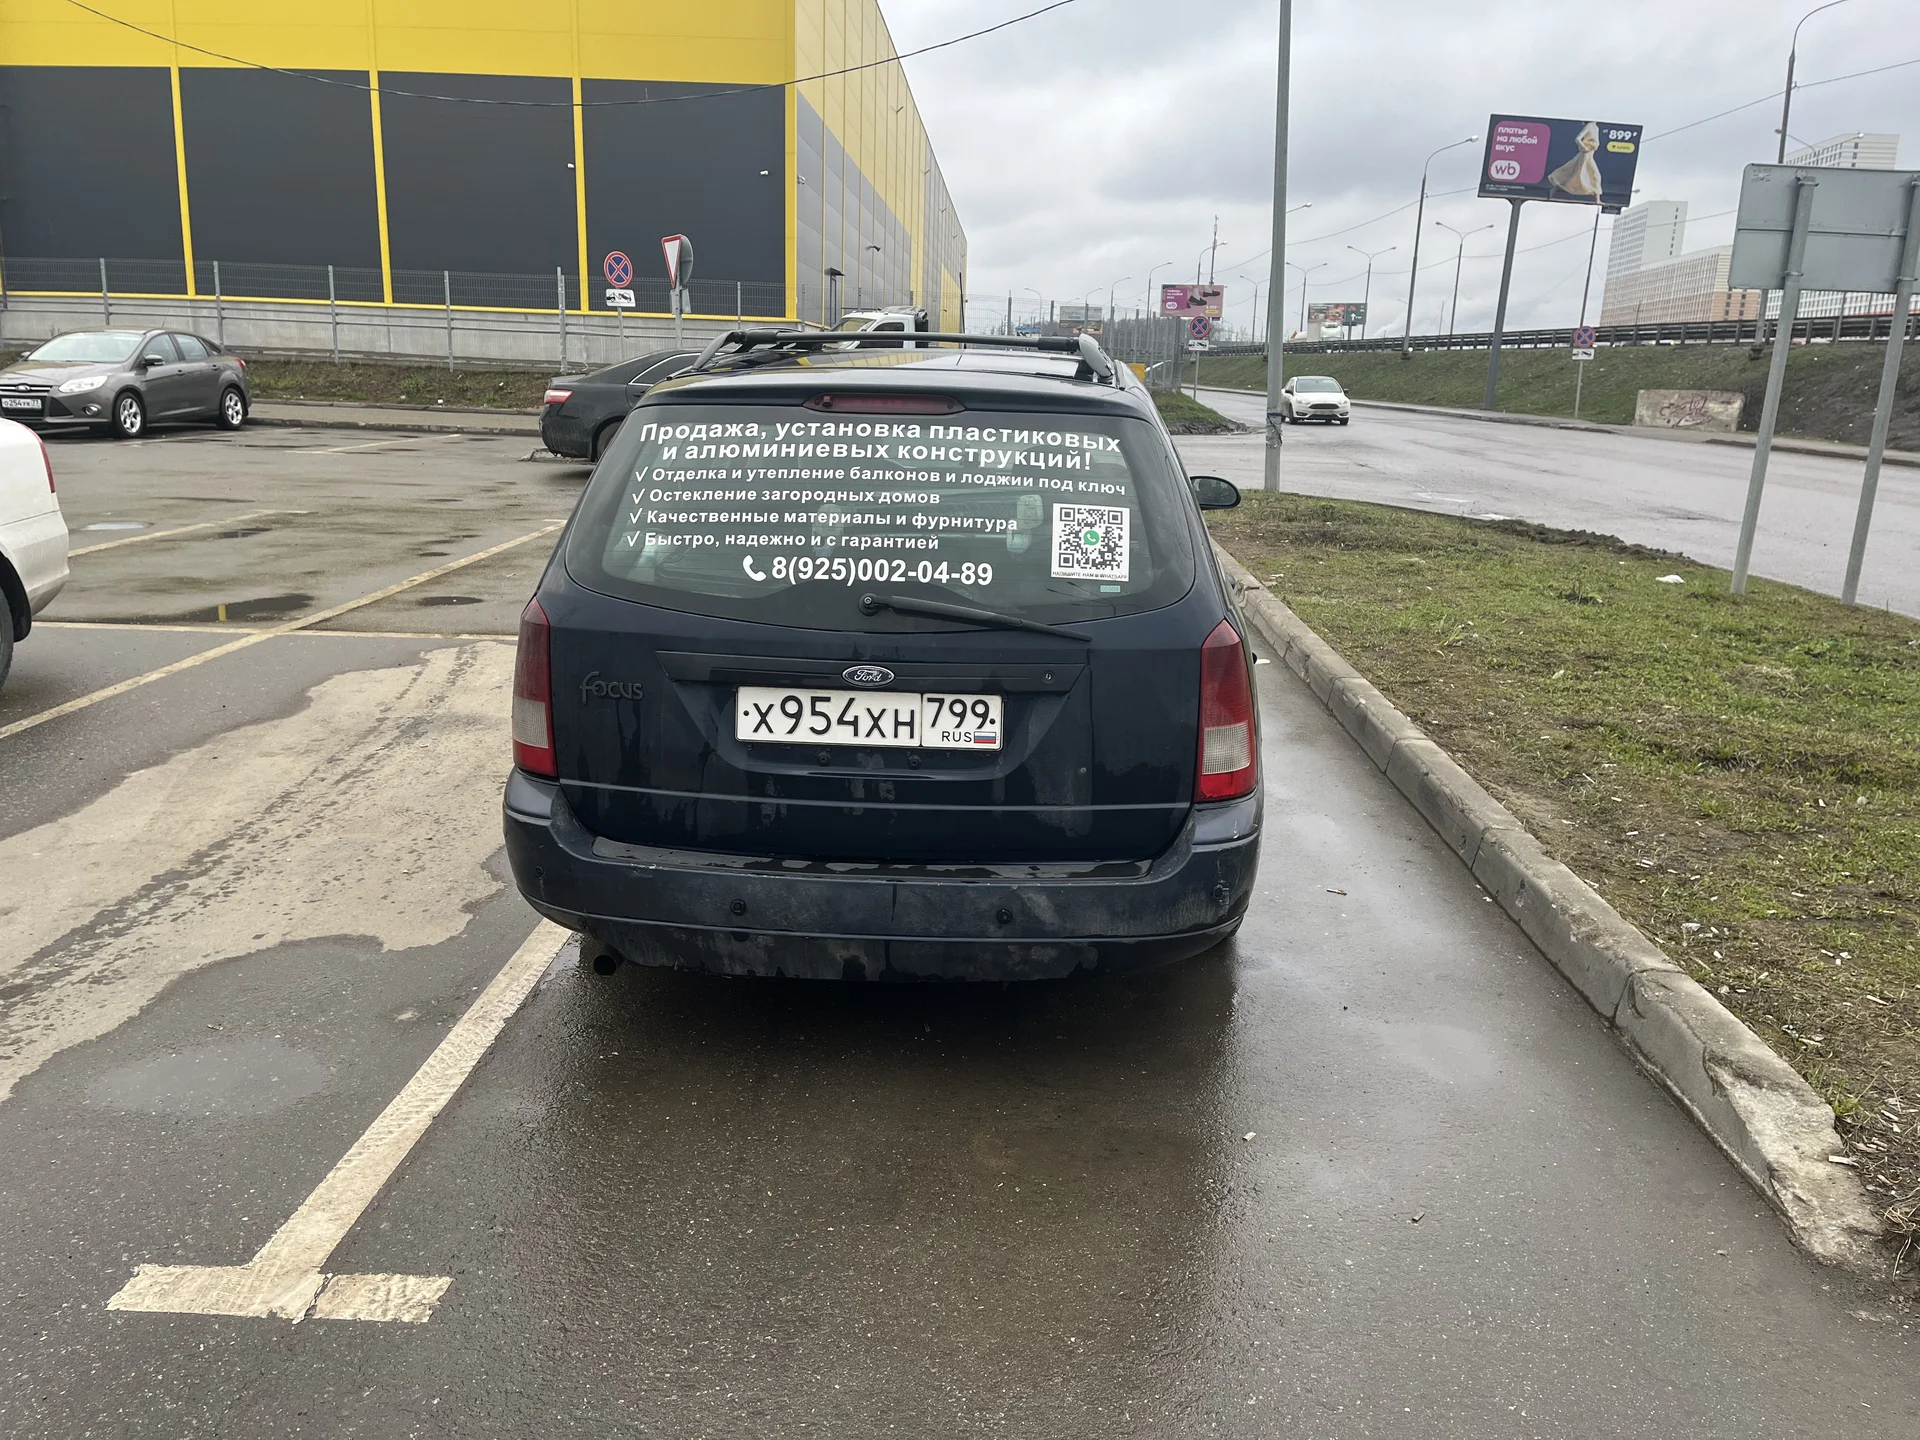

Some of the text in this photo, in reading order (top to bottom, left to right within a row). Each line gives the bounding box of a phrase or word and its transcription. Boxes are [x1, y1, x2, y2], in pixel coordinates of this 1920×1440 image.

[1498, 126, 1529, 135] платье
[1495, 144, 1515, 153] вкус
[1508, 135, 1538, 145] любой
[1495, 162, 1516, 175] wb
[640, 421, 1121, 453] Продажа, установка пластиковых
[662, 443, 1091, 471] и алюминиевых конструкций!
[652, 466, 1126, 495] Отделка и утепление балконов и лоджии под ключ
[649, 488, 941, 504] Остекление загородных домов
[646, 509, 1018, 533] Качественные материалы и фурнитура
[644, 532, 940, 551] Быстро, надежно и с гарантией
[772, 556, 993, 586] 8(925)002-04-89
[853, 668, 883, 682] Ford
[752, 694, 990, 740] Х954ХН 799
[941, 730, 973, 743] RUS
